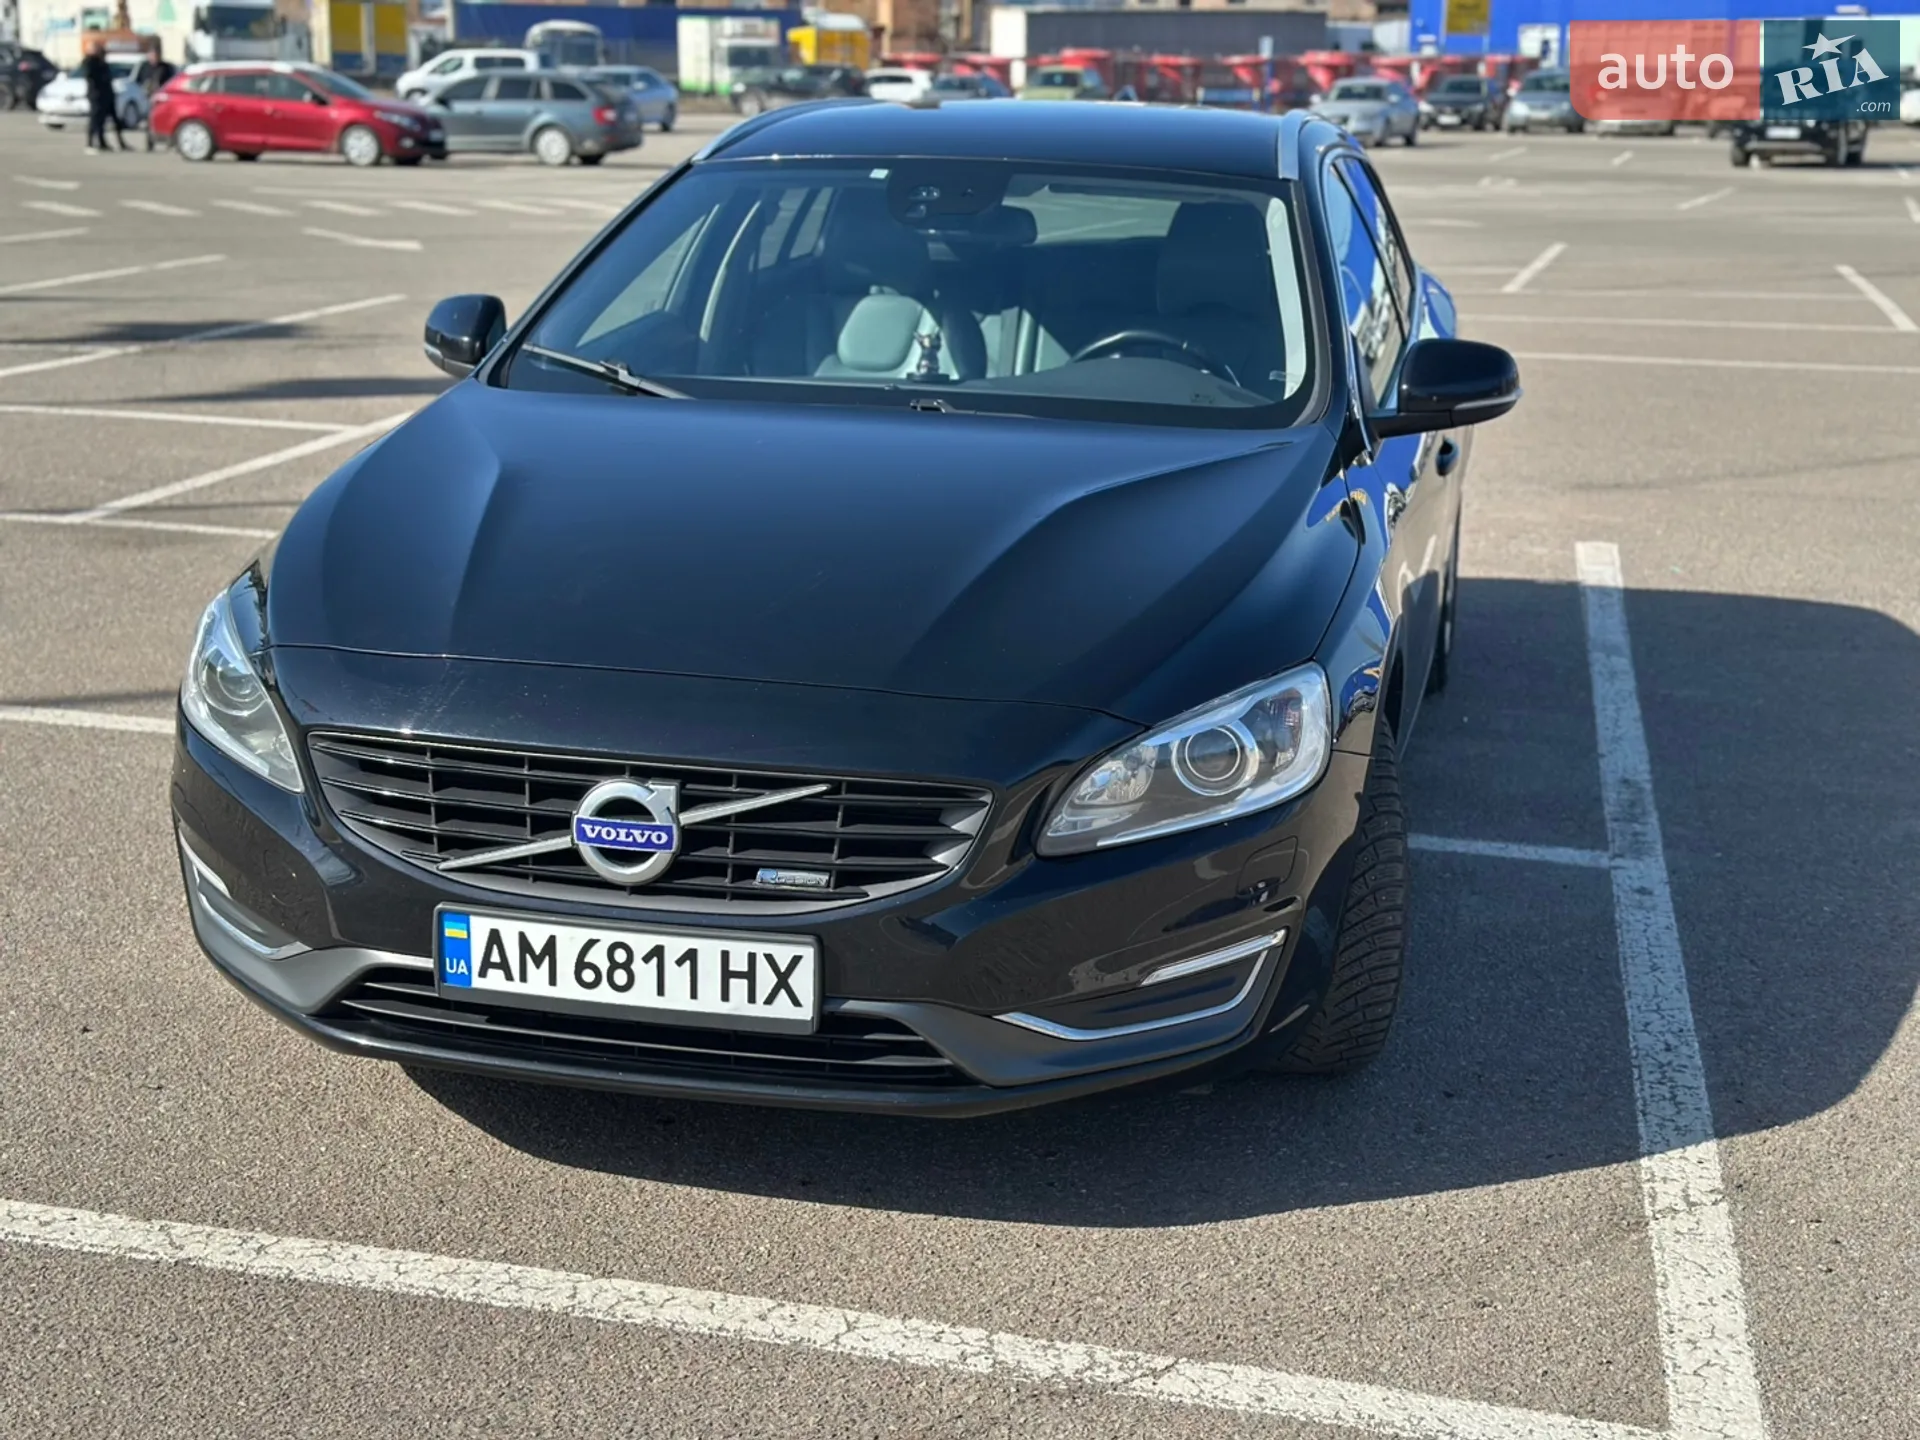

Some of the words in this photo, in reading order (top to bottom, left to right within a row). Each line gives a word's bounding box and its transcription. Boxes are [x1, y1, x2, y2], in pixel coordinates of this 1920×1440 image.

[581, 824, 668, 844] VOLVO
[446, 958, 468, 975] UA
[478, 928, 557, 987] AM
[574, 938, 698, 1000] 6811
[720, 950, 803, 1007] HX
